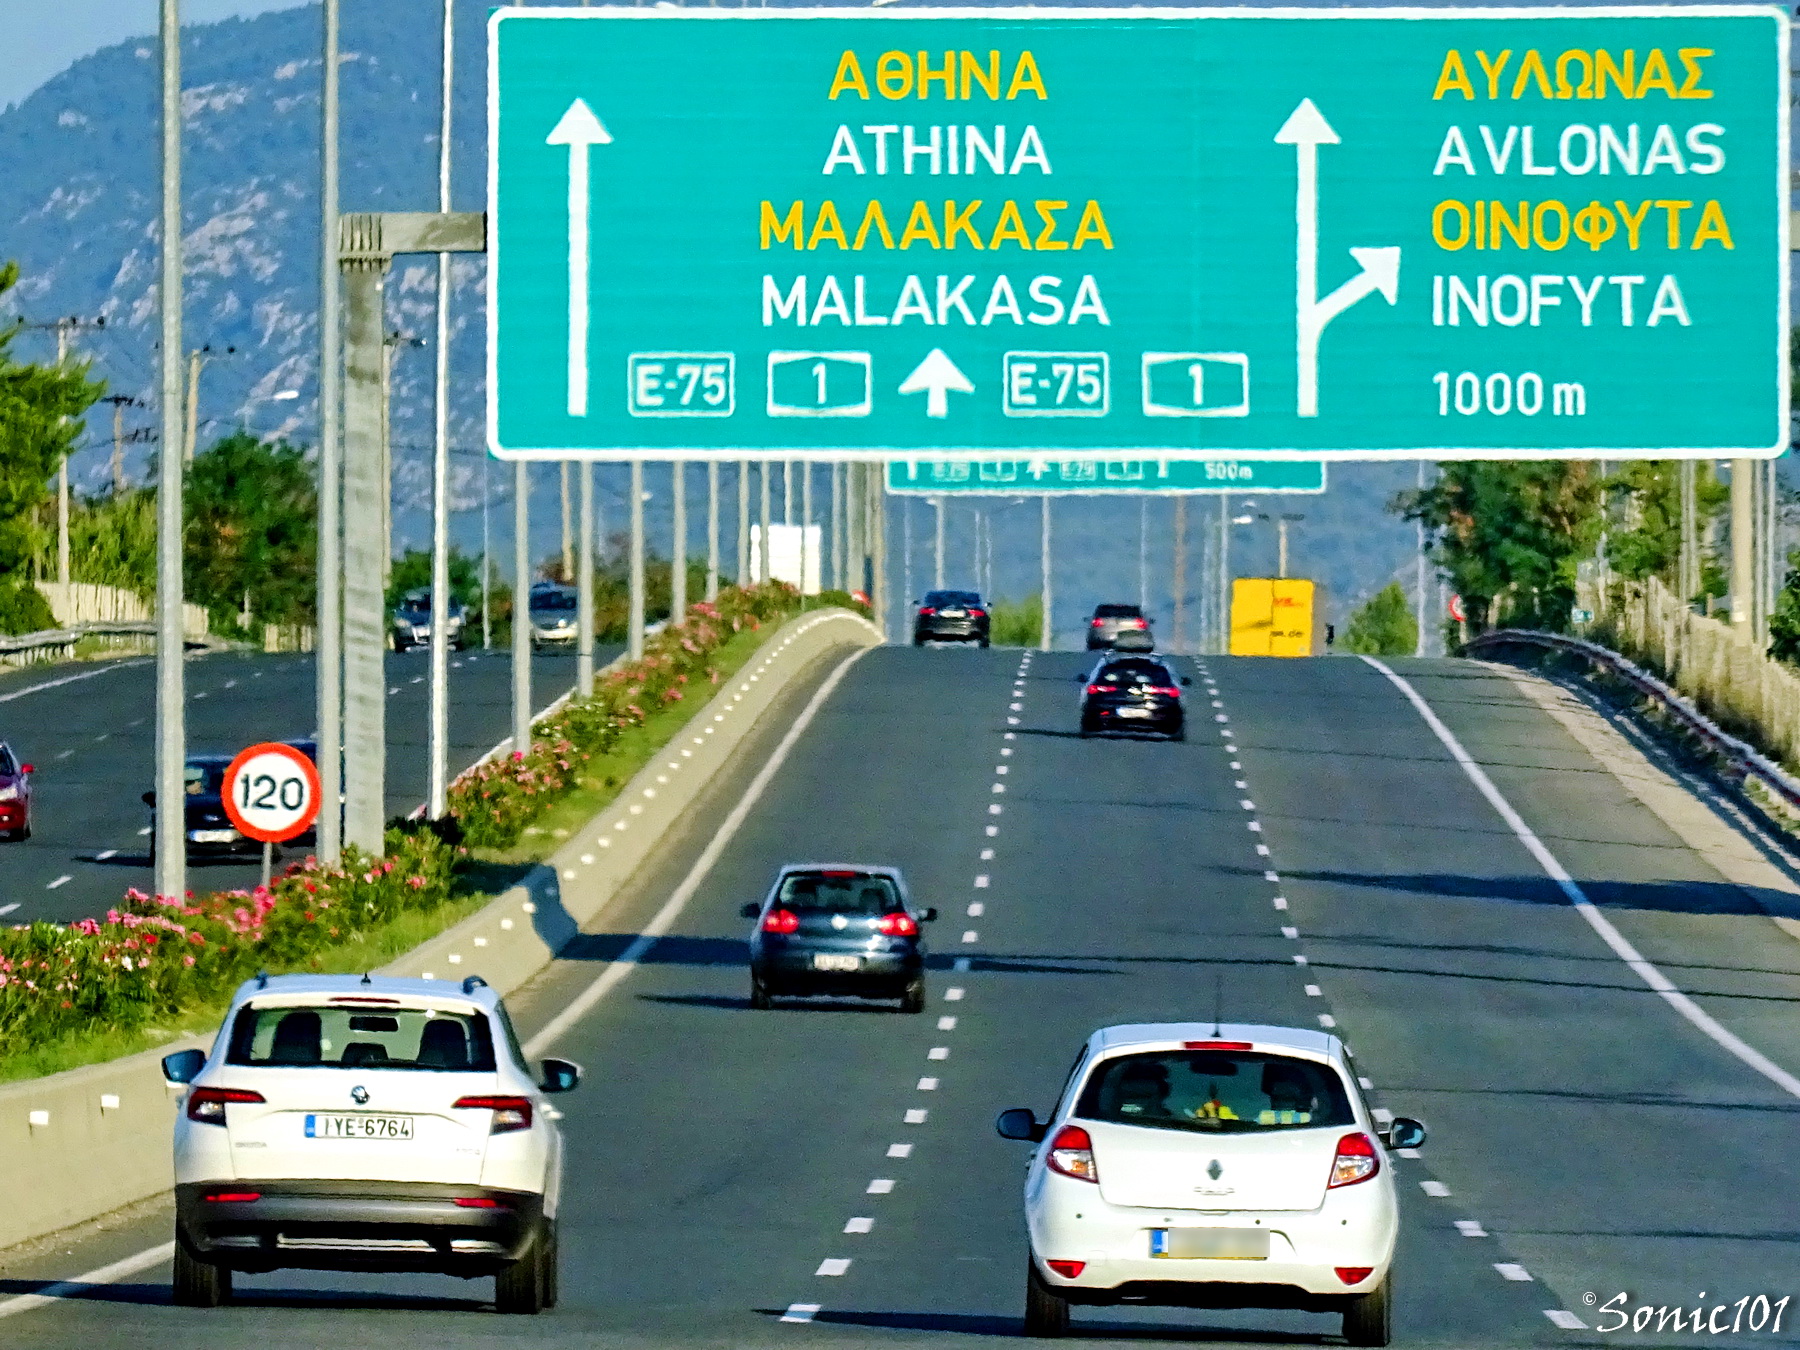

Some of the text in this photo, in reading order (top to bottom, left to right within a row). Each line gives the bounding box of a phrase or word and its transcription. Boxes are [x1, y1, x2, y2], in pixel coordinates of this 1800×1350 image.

[828, 50, 1048, 100] ΑΘΗΝΑ
[1432, 48, 1715, 100] ΑΥΛΩΝΑΣ
[822, 124, 1053, 175] ATHINA
[1432, 123, 1726, 176] AVLONAS
[759, 199, 1114, 251] ΜΑΛΑΚΑΣΑ
[1432, 199, 1735, 252] ΟΙΝΟΦΥΤΑ
[762, 274, 1111, 327] MALAKASA
[1432, 274, 1692, 327] INOFYTA
[635, 362, 727, 406] E-75
[811, 363, 827, 405] 1
[1010, 362, 1101, 406] E-75
[1188, 363, 1204, 405] 1
[1432, 371, 1586, 416] 1000 m
[241, 773, 304, 811] 120
